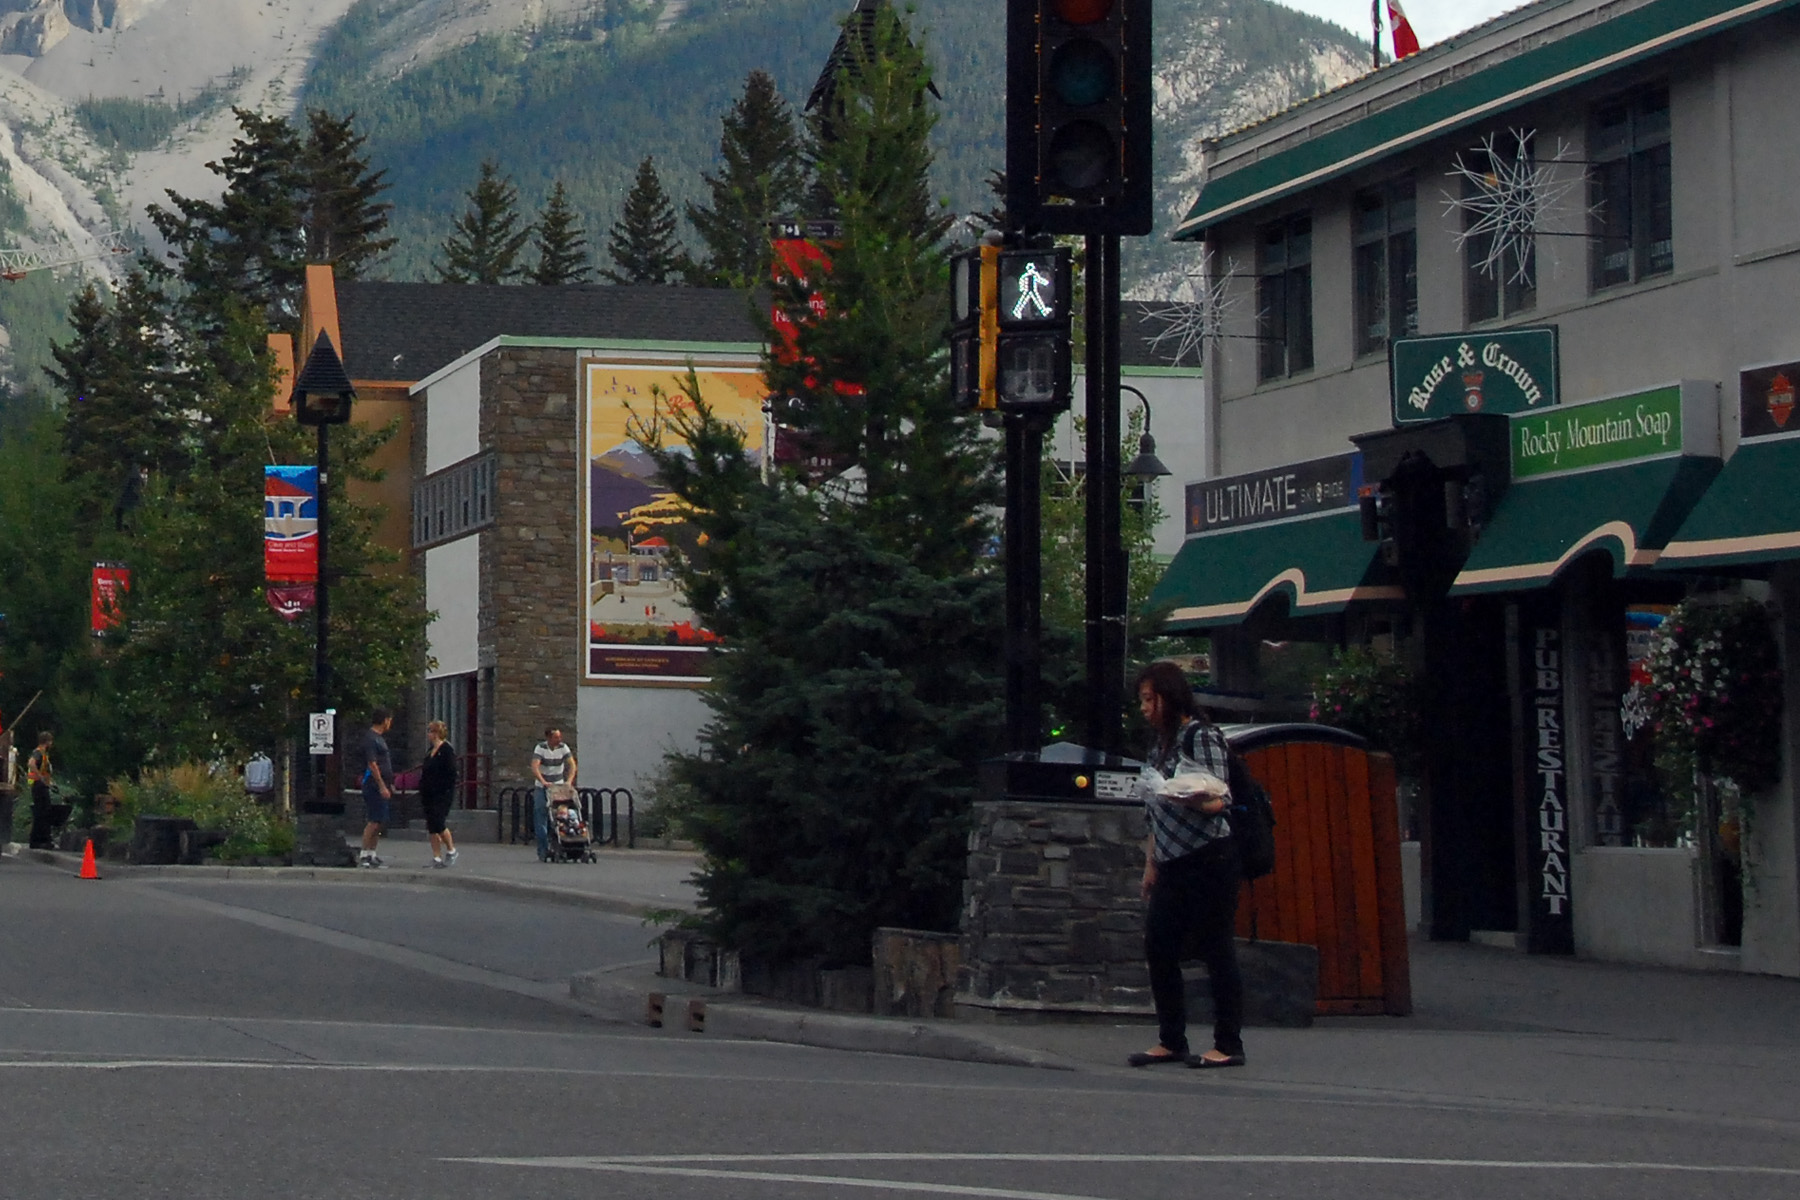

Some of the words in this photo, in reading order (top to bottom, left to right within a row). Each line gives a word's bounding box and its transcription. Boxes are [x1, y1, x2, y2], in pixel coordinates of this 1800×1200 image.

[1408, 355, 1454, 413] Rose
[1457, 342, 1475, 368] &
[1482, 341, 1543, 405] Crown
[1521, 420, 1561, 464] Rocky
[1566, 411, 1633, 450] Mountain
[1636, 404, 1671, 446] Soap
[1206, 473, 1297, 524] ULTIMATE
[1535, 628, 1560, 690] PUB
[1536, 707, 1568, 915] RESTAURANT
